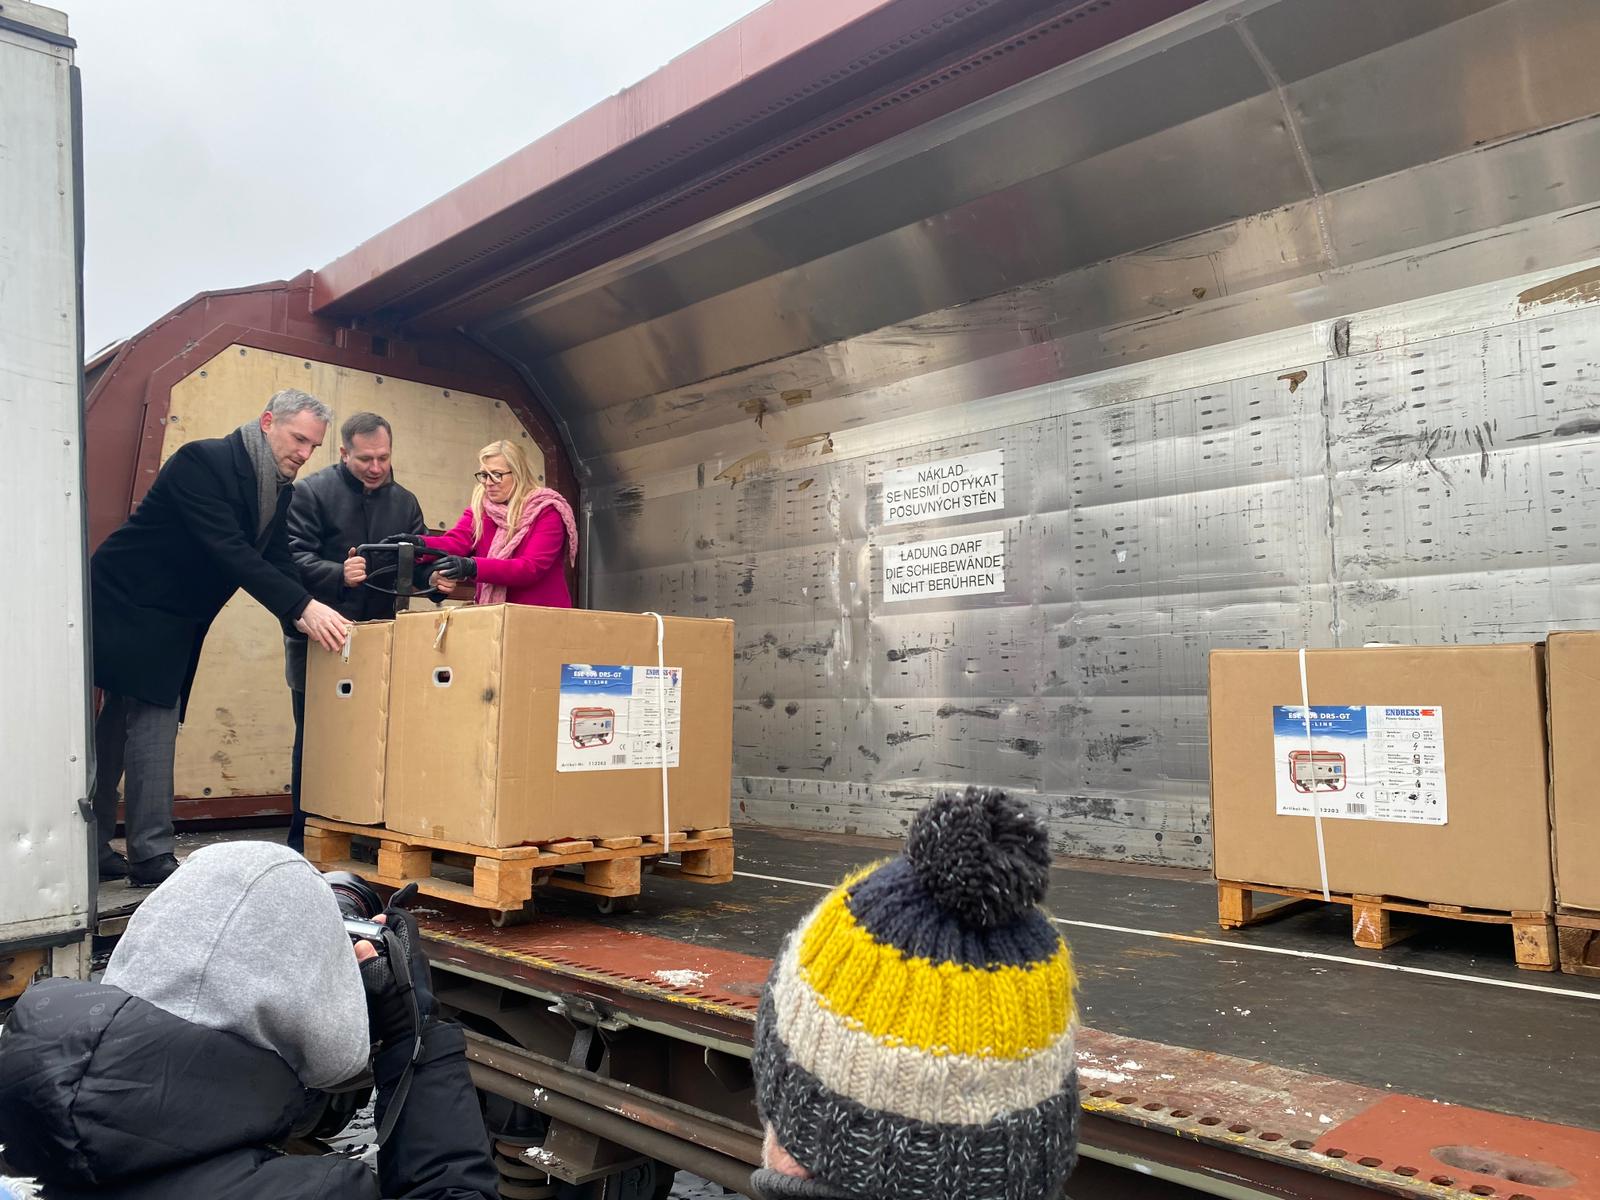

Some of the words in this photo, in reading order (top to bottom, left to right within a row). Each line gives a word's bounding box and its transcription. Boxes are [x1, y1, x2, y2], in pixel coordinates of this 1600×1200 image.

[918, 464, 964, 483] NÁKLAD
[886, 490, 901, 504] SE
[903, 483, 939, 501] NESMÍ
[942, 473, 999, 494] DOTÝKAT
[889, 497, 961, 519] POSUVNÝCH
[963, 490, 997, 508] STĚN
[900, 544, 948, 562] LADUNG
[951, 540, 983, 555] DARF
[885, 566, 903, 580] DIE
[906, 554, 1001, 578] SCHIEBEWÄNDE
[891, 580, 925, 595] NICHT
[928, 573, 995, 592] BERÜHREN
[1385, 708, 1420, 716] ENDRESS
